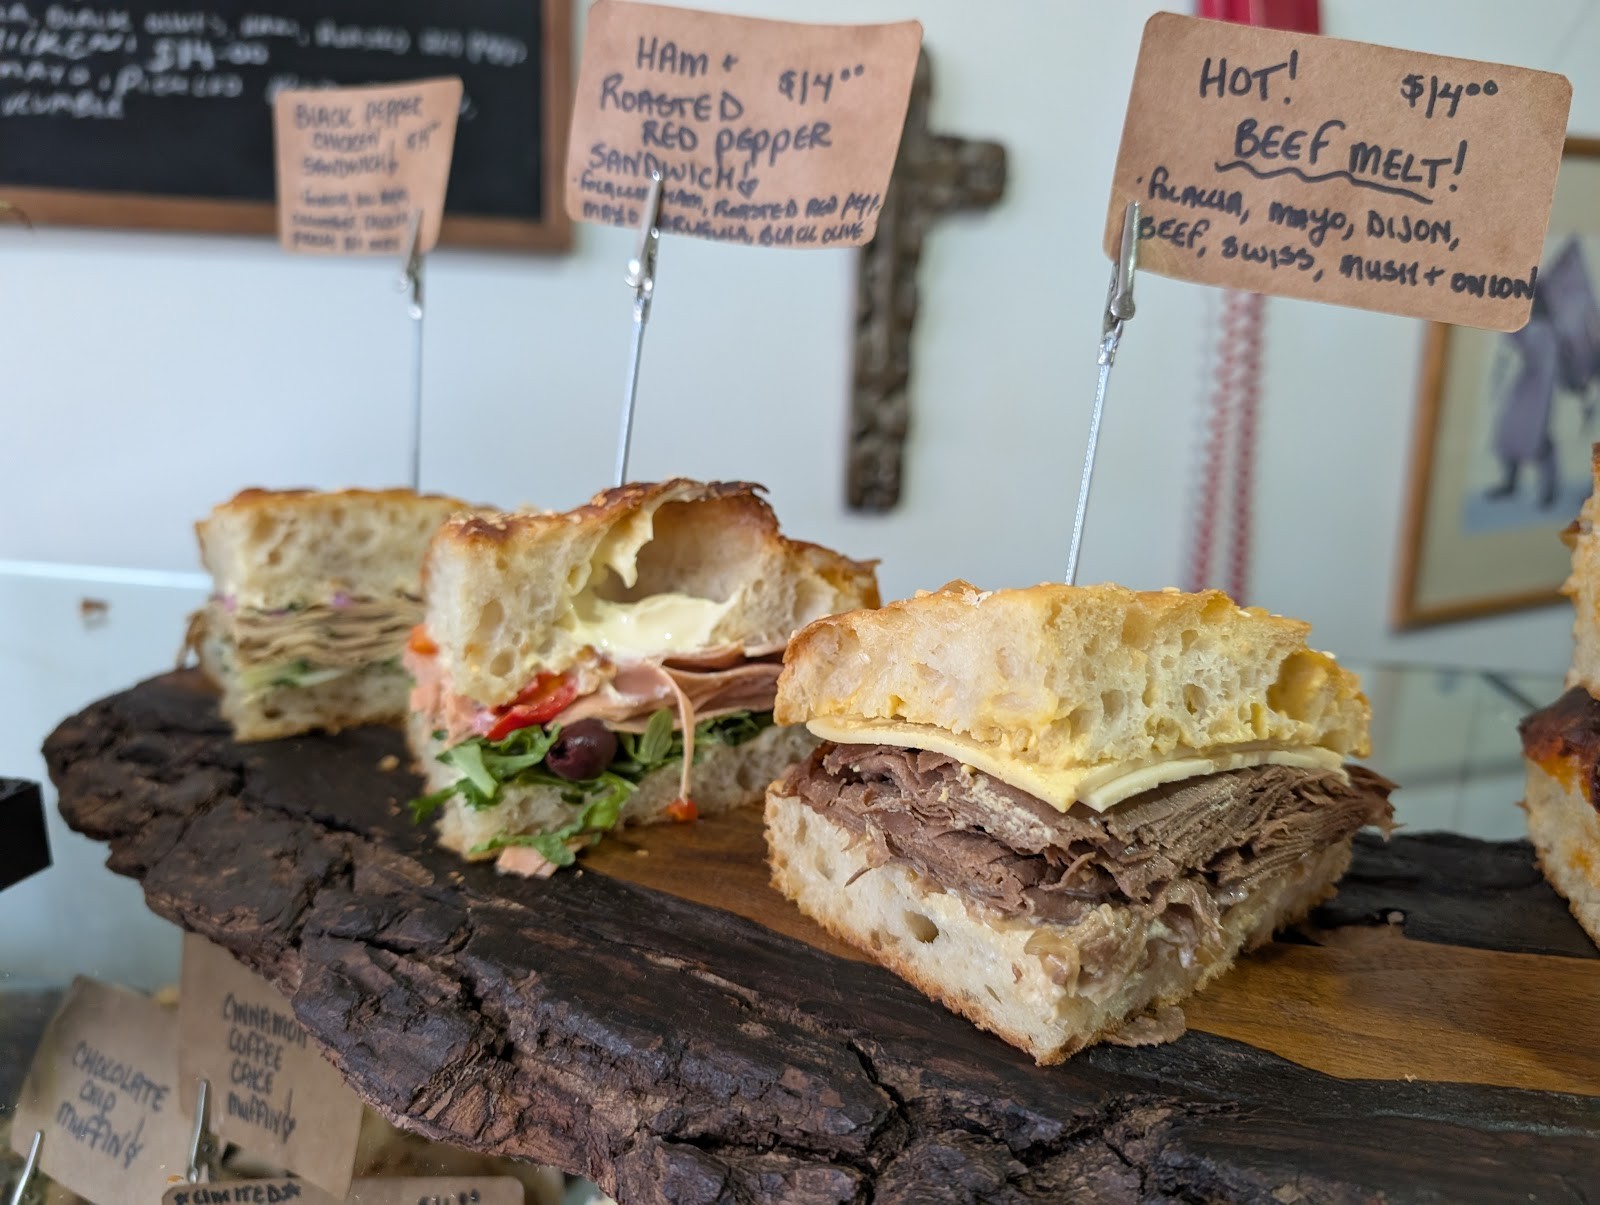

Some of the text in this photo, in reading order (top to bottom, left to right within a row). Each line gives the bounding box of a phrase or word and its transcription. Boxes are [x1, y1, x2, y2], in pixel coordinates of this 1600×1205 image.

[636, 36, 709, 77] HAM
[1199, 49, 1299, 105] HOT!
[293, 102, 355, 130] BLACK
[599, 72, 744, 122] ROASTED
[642, 119, 832, 168] RED PEPPER
[1233, 117, 1468, 193] BEEF MELT!
[1268, 200, 1355, 248] MAYO,
[1366, 209, 1460, 252] DIJON,
[1137, 215, 1210, 259] BEEF,
[1221, 235, 1324, 284] SWISS,
[1449, 265, 1539, 300] ONION
[228, 1027, 284, 1072] COFFEE
[72, 1041, 171, 1112] CHOCOLATE
